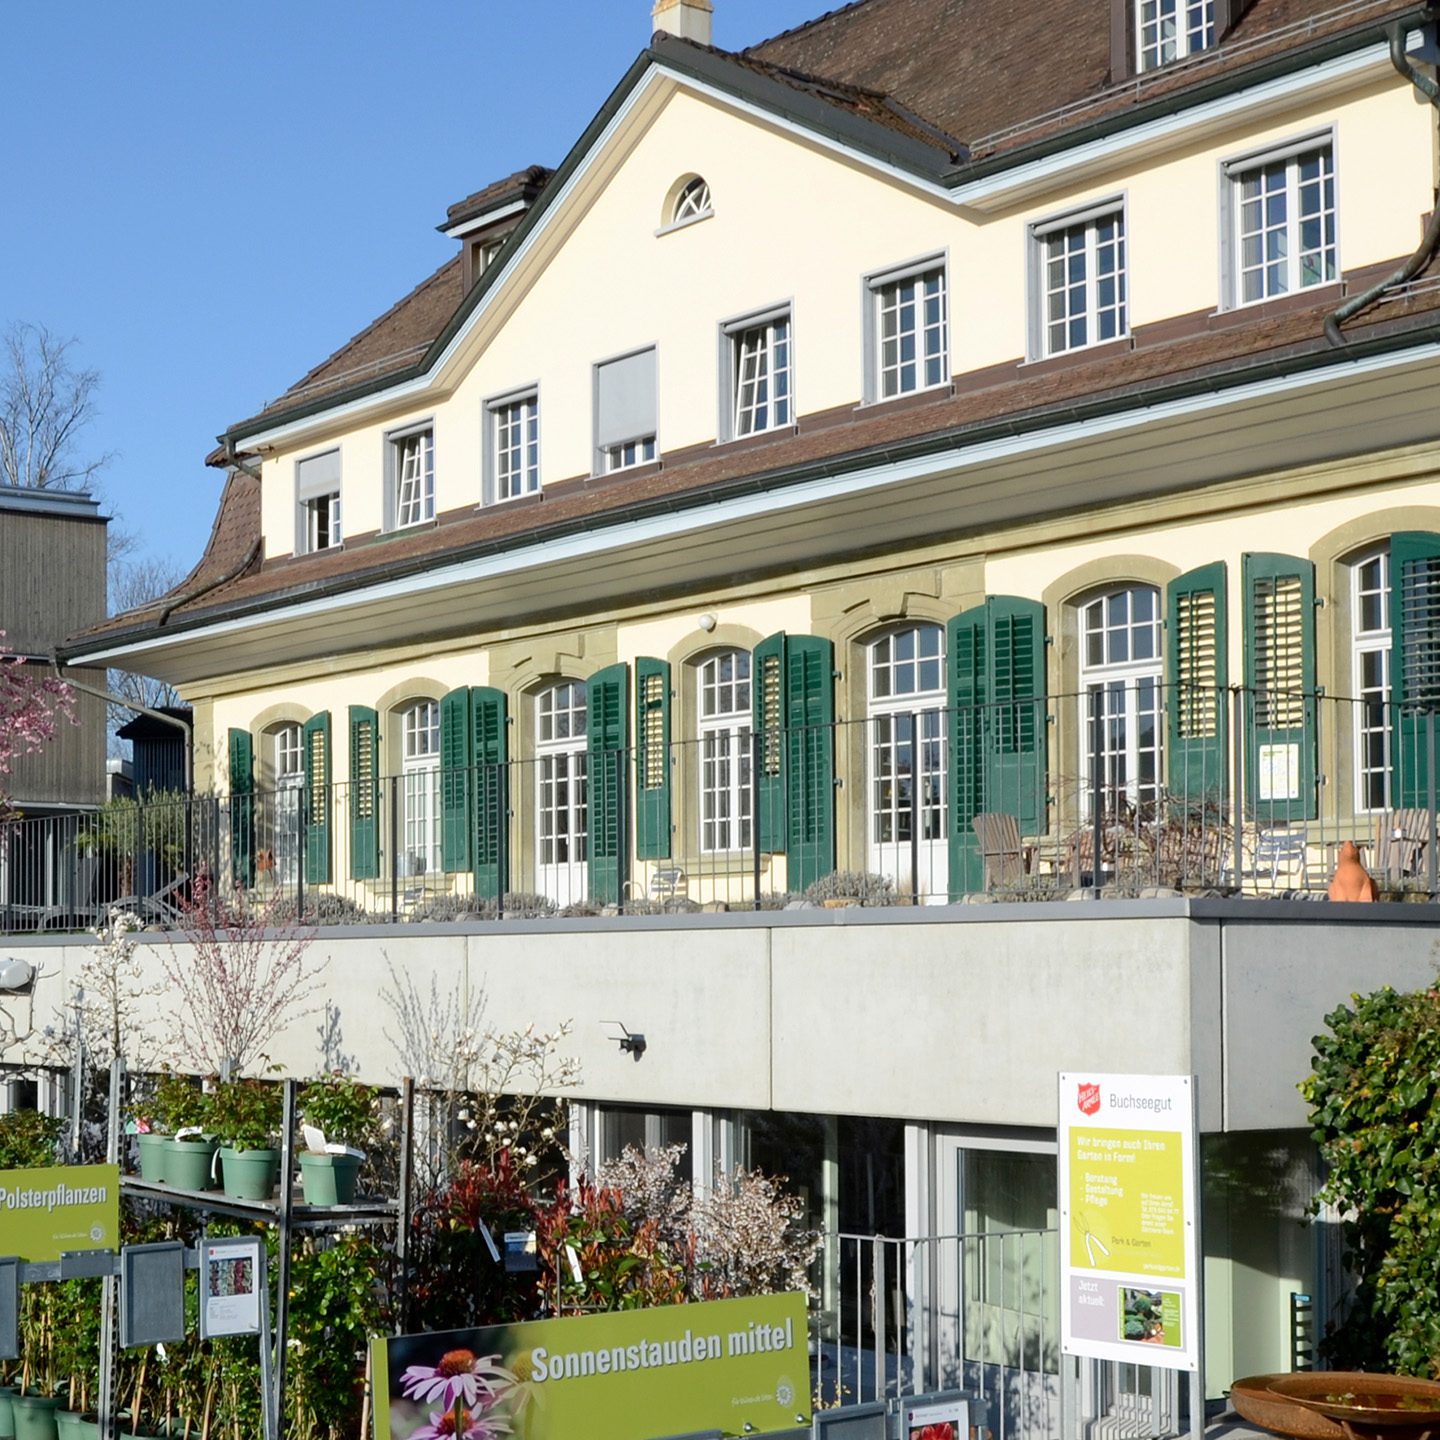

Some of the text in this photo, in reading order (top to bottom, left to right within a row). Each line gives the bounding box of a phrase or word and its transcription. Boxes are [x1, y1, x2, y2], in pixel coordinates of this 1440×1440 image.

[1109, 1093, 1172, 1113] Buchseegut
[1077, 1136, 1166, 1151] Wir bringen auch Ihren
[1077, 1150, 1103, 1161] Garten
[1078, 1279, 1099, 1292] Jetzt
[531, 1317, 792, 1383] Sonnenstauden mittel
